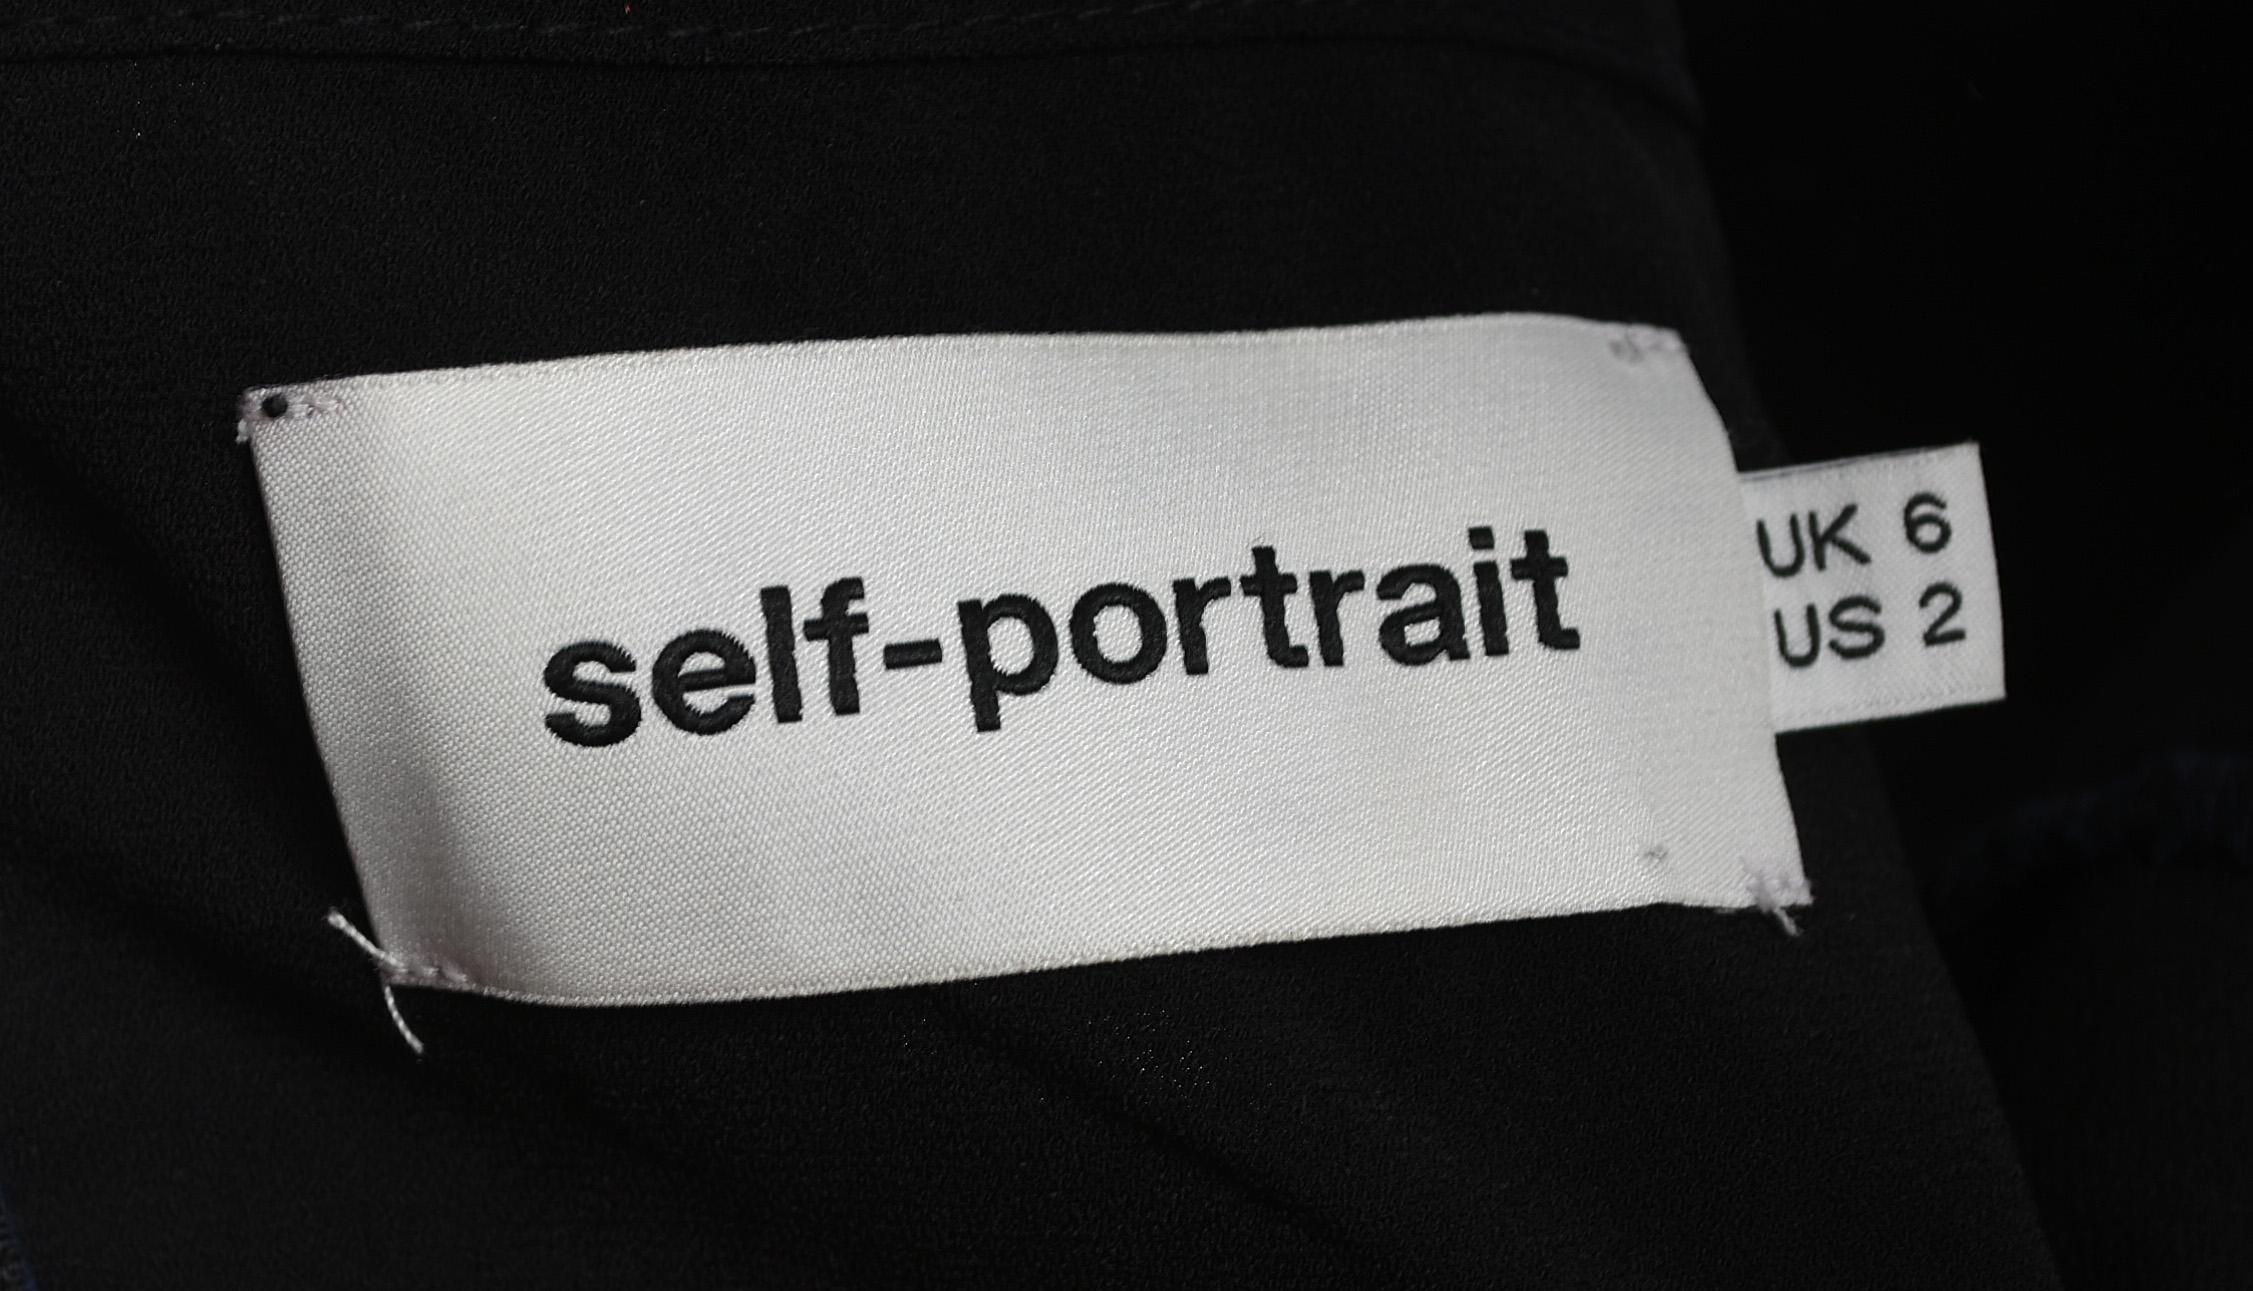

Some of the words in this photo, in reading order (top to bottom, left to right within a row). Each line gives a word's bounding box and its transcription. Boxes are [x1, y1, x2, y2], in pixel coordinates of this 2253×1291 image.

[1756, 503, 1871, 579] UK
[1903, 492, 1952, 554] 6
[543, 526, 1582, 748] self-portrait
[1773, 595, 1885, 669] US
[1918, 581, 1966, 647] 2
